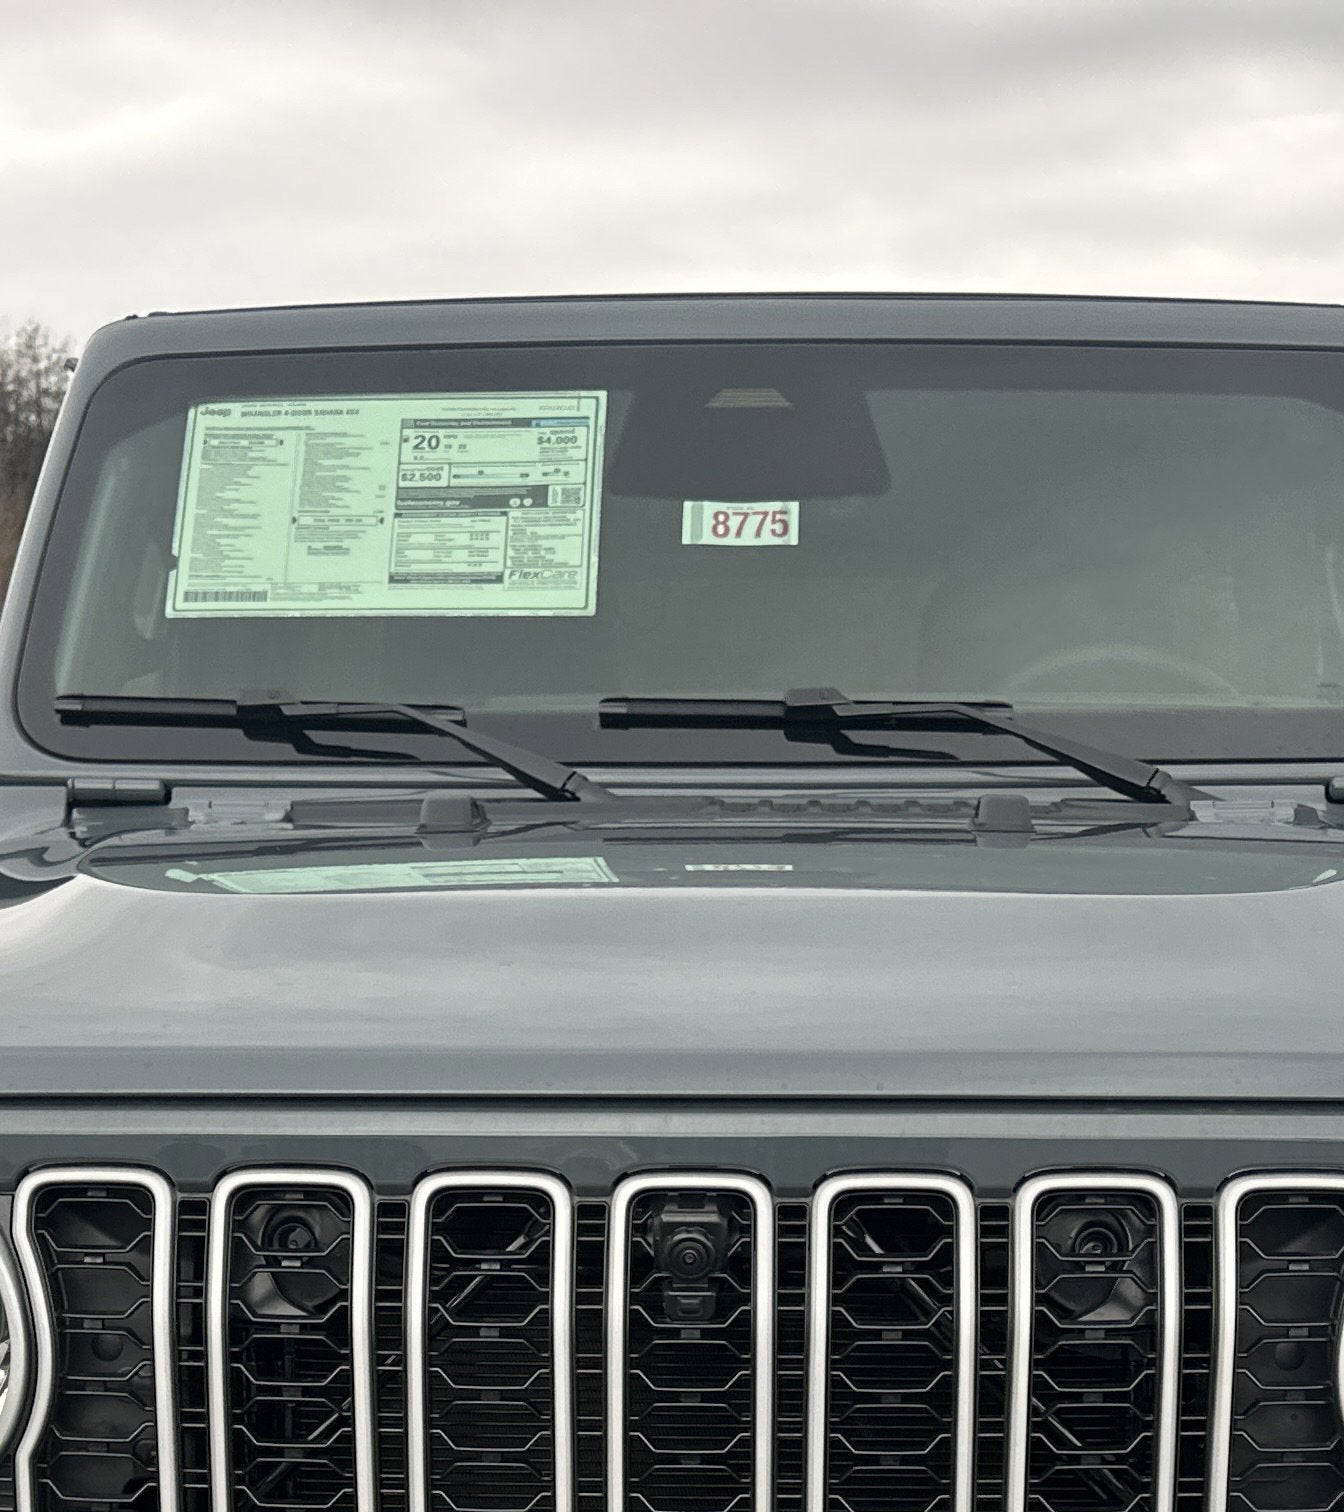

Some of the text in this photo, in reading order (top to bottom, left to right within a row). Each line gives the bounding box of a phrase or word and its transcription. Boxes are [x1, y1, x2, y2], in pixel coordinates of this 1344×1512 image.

[199, 406, 232, 418] Jeep
[413, 434, 441, 450] 20
[537, 435, 578, 446] $4,000
[401, 472, 442, 483] $2,500
[711, 510, 789, 539] 8775
[508, 569, 578, 580] FlexCare
